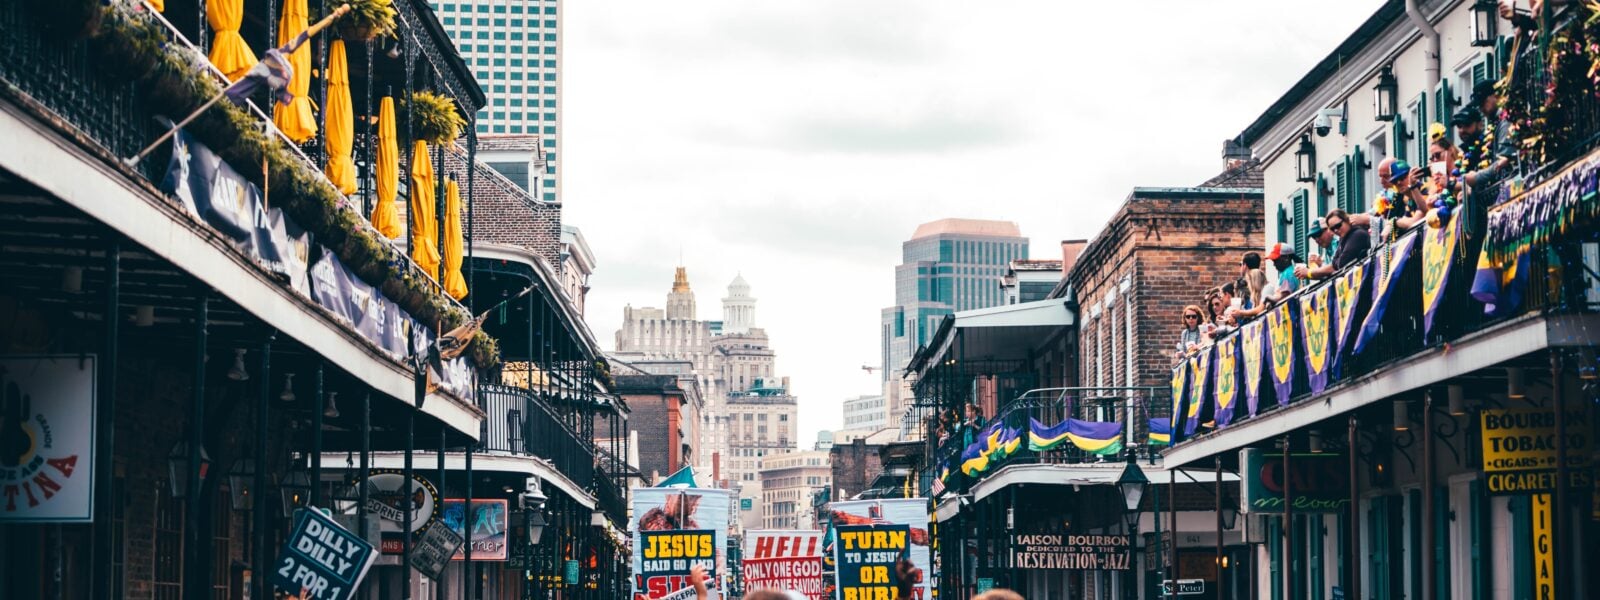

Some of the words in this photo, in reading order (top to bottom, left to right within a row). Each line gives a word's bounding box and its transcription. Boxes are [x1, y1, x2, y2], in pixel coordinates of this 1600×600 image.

[1488, 433, 1585, 452] TOBACO
[1493, 457, 1538, 468] CIGARS
[1488, 470, 1590, 492] CIGARETES
[367, 499, 403, 521] CORNE
[305, 518, 361, 559] DILLY
[644, 534, 713, 559] JESUS
[840, 530, 906, 550] TURN
[1069, 535, 1130, 546] BOURBON
[297, 535, 353, 576] DILLY
[643, 559, 671, 572] SAID
[673, 559, 687, 571] GO
[845, 552, 862, 564] TO
[1103, 549, 1130, 569] JAZZ
[278, 557, 295, 578] 2
[292, 564, 328, 598] FOR
[327, 586, 341, 600] 1
[745, 561, 772, 580] ONLY
[773, 561, 791, 578] ONE
[792, 560, 820, 577] GOD
[860, 565, 889, 584] OR
[746, 579, 772, 594] ONLY
[773, 579, 792, 593] ONE
[793, 578, 821, 593] SAVIOR
[1179, 584, 1202, 592] Peter
